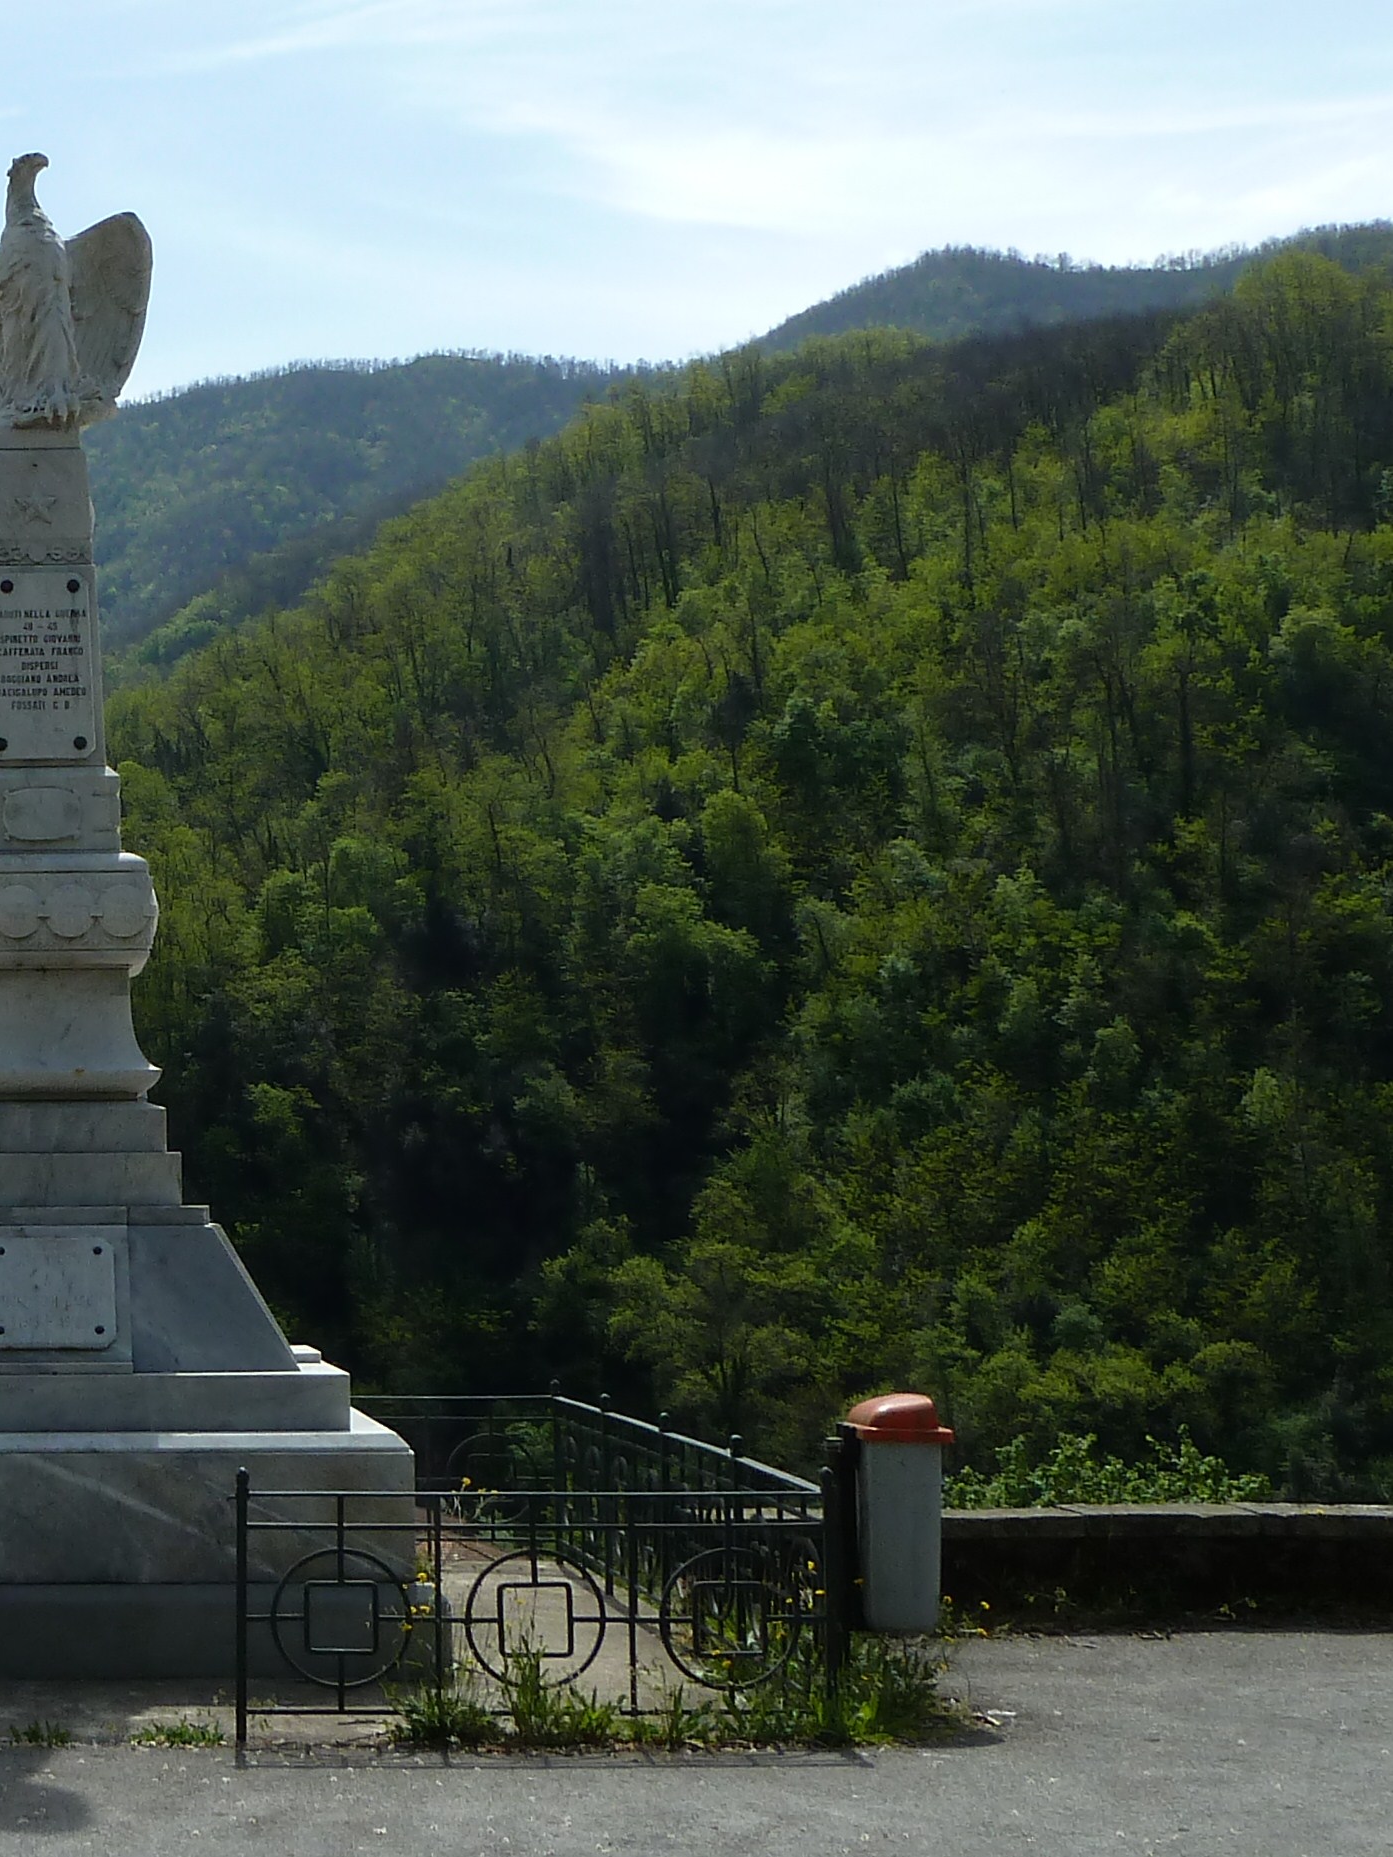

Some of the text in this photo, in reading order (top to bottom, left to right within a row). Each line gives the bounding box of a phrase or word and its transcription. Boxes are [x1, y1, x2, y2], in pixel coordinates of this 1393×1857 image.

[24, 609, 50, 619] NELLA
[43, 634, 81, 643] GIOVANNI
[51, 647, 84, 656] FRANCO
[21, 661, 58, 671] DISPERSI
[46, 674, 80, 683] ANDREA
[53, 687, 86, 696] AMEDEO
